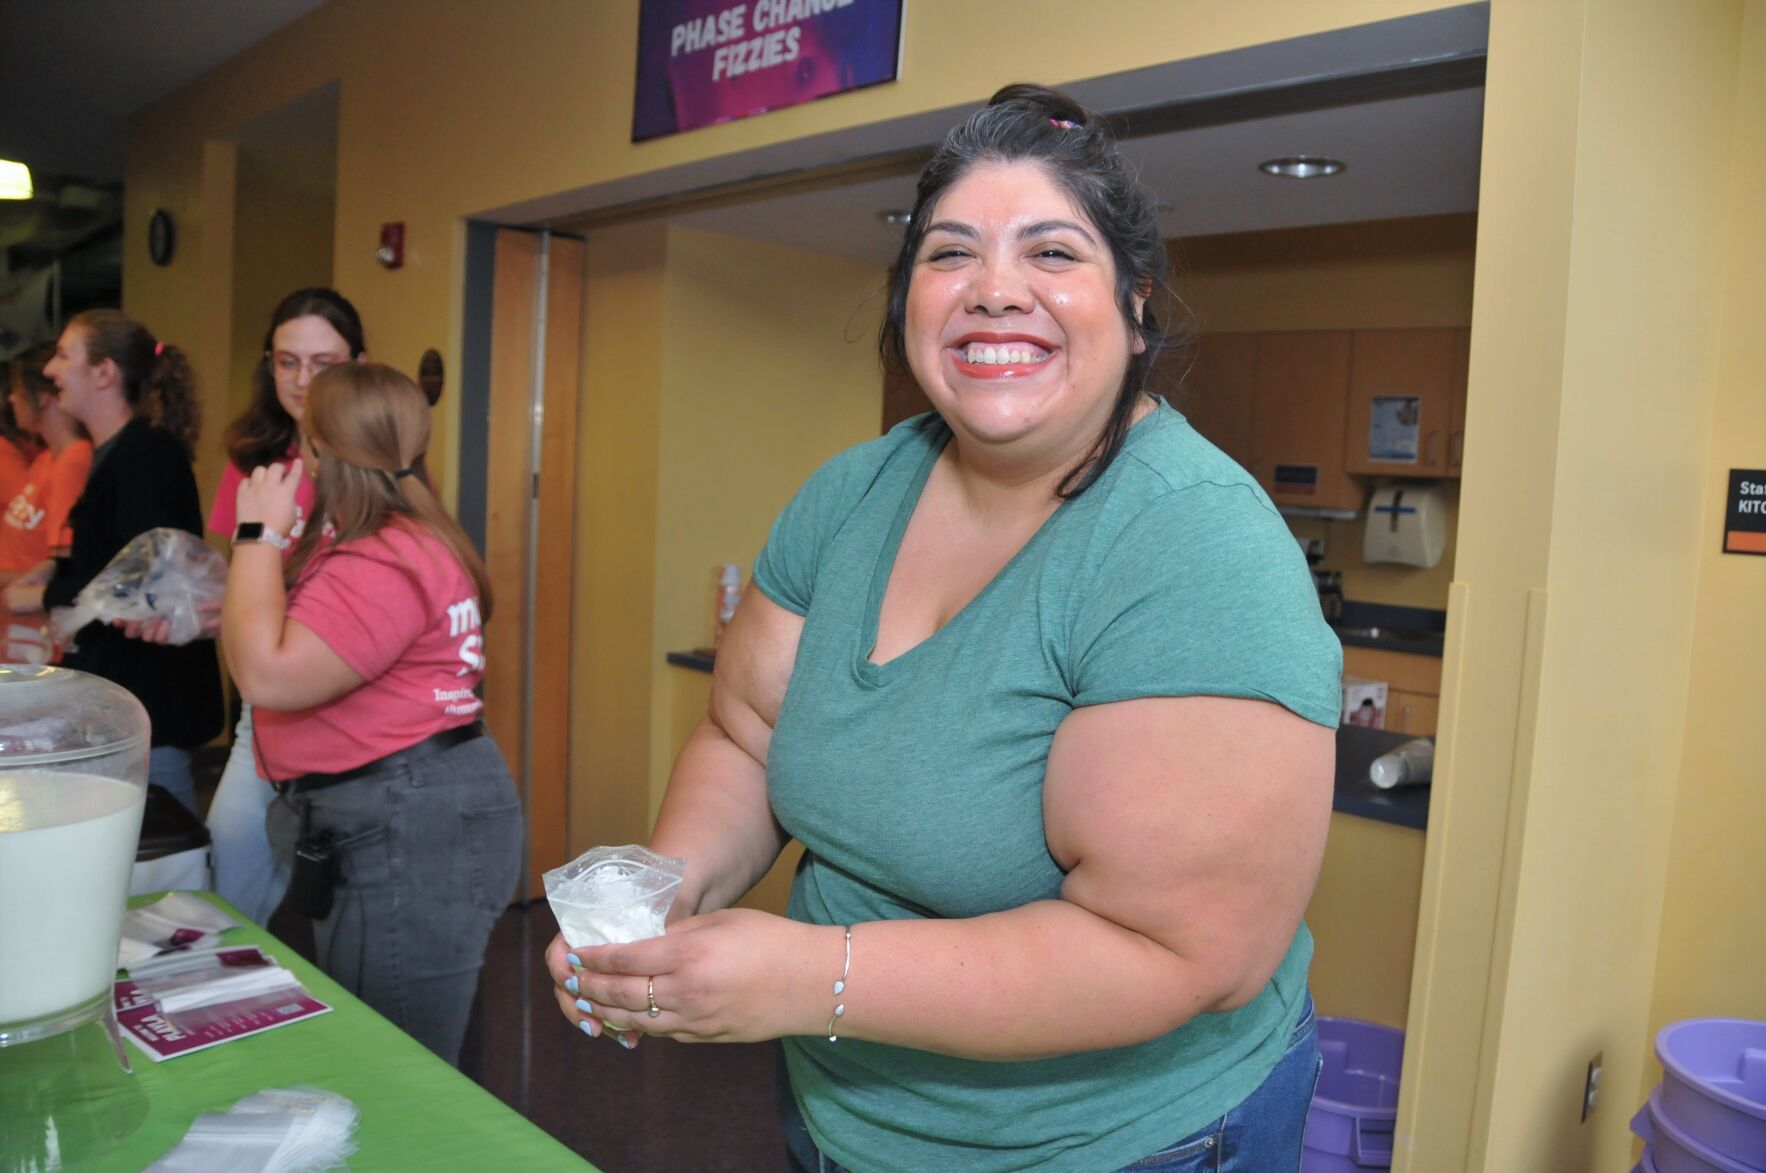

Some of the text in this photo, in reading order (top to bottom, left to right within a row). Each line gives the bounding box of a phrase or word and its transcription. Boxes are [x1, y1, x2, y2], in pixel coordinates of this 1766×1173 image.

[671, 0, 856, 57] PHASE CHAN
[712, 26, 801, 82] FIZZIES
[1740, 481, 1766, 495] Sta
